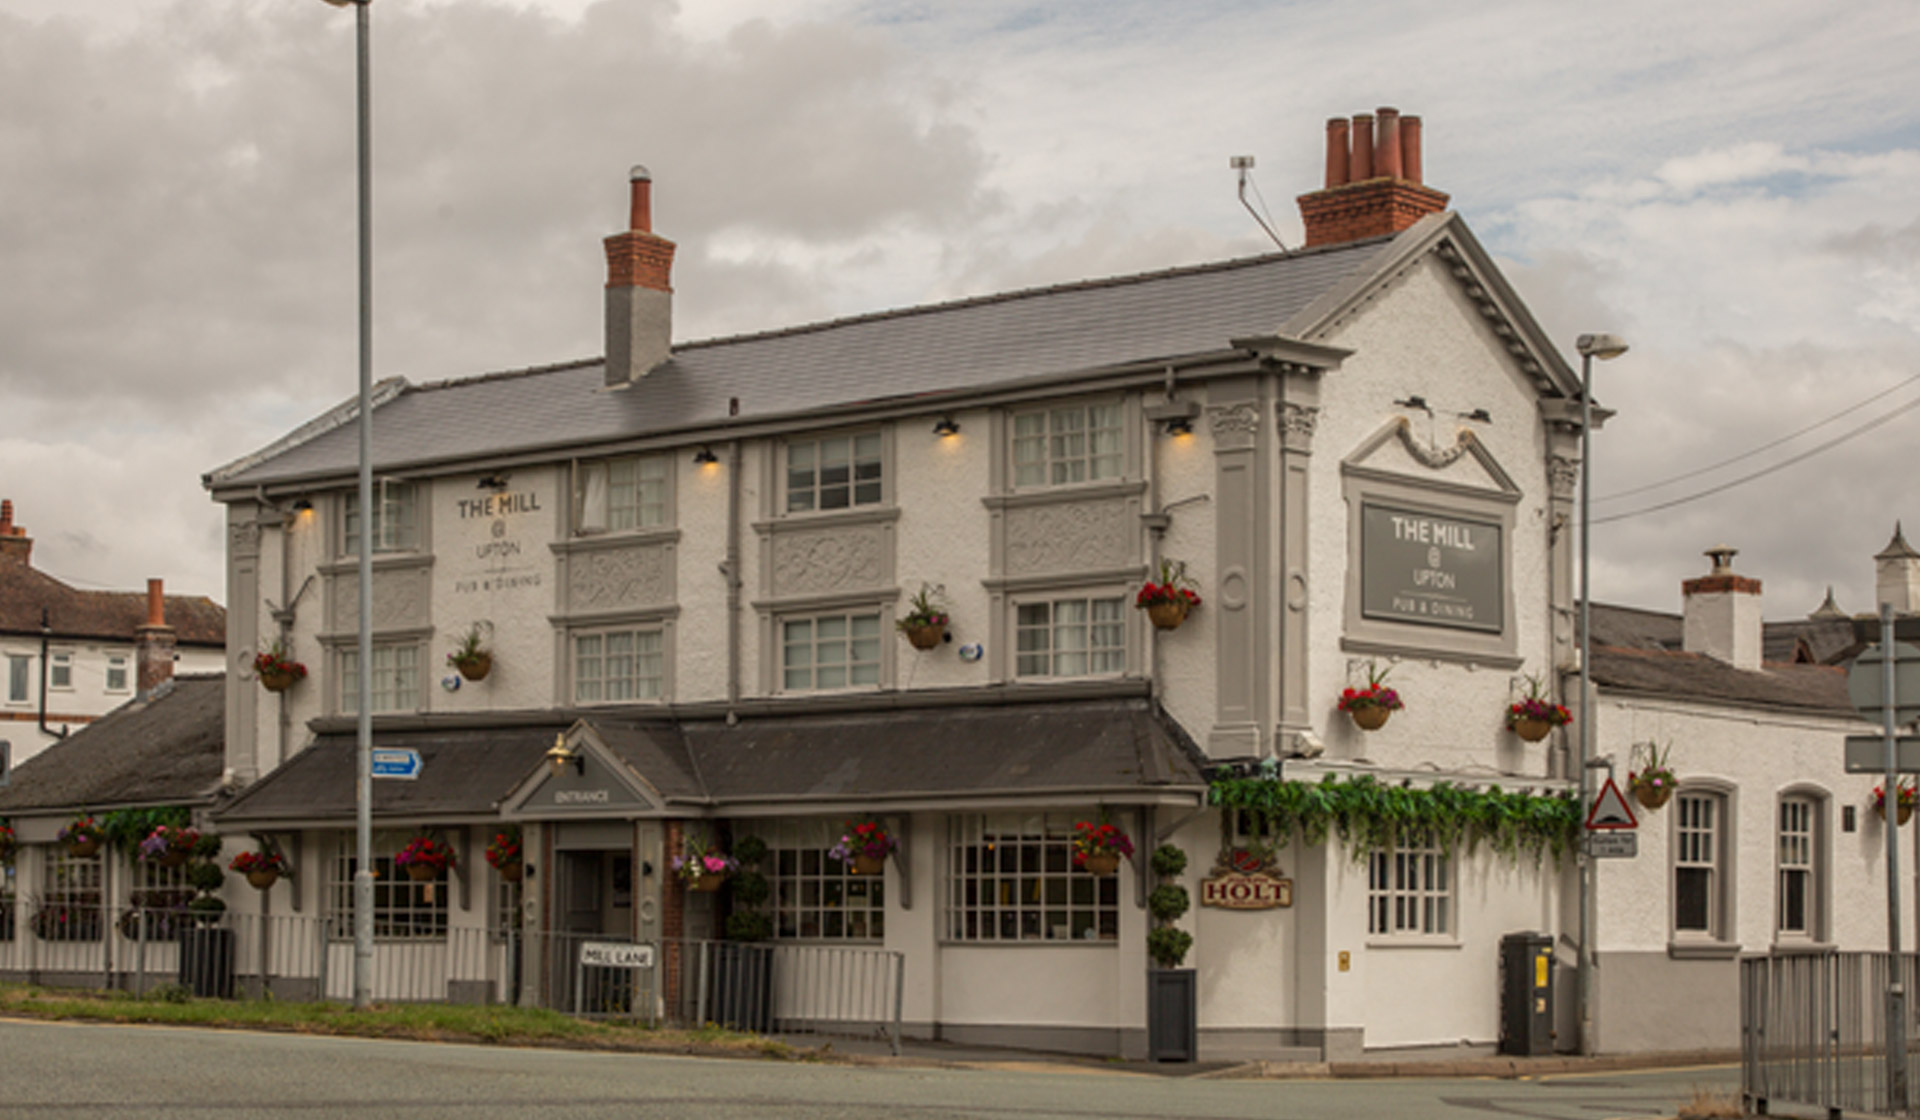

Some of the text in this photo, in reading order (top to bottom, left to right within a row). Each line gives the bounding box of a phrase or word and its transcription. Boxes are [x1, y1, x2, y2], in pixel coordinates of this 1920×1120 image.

[458, 492, 541, 518] THE MILL
[1391, 516, 1475, 550] THE MILL
[476, 541, 521, 559] UPTON
[1413, 569, 1456, 589] UPTON
[1393, 597, 1416, 613] PUB
[1431, 601, 1474, 620] DINING
[554, 789, 609, 803] ENTRANCE
[1207, 883, 1288, 900] HOLT
[585, 949, 648, 964] MILL LANE
